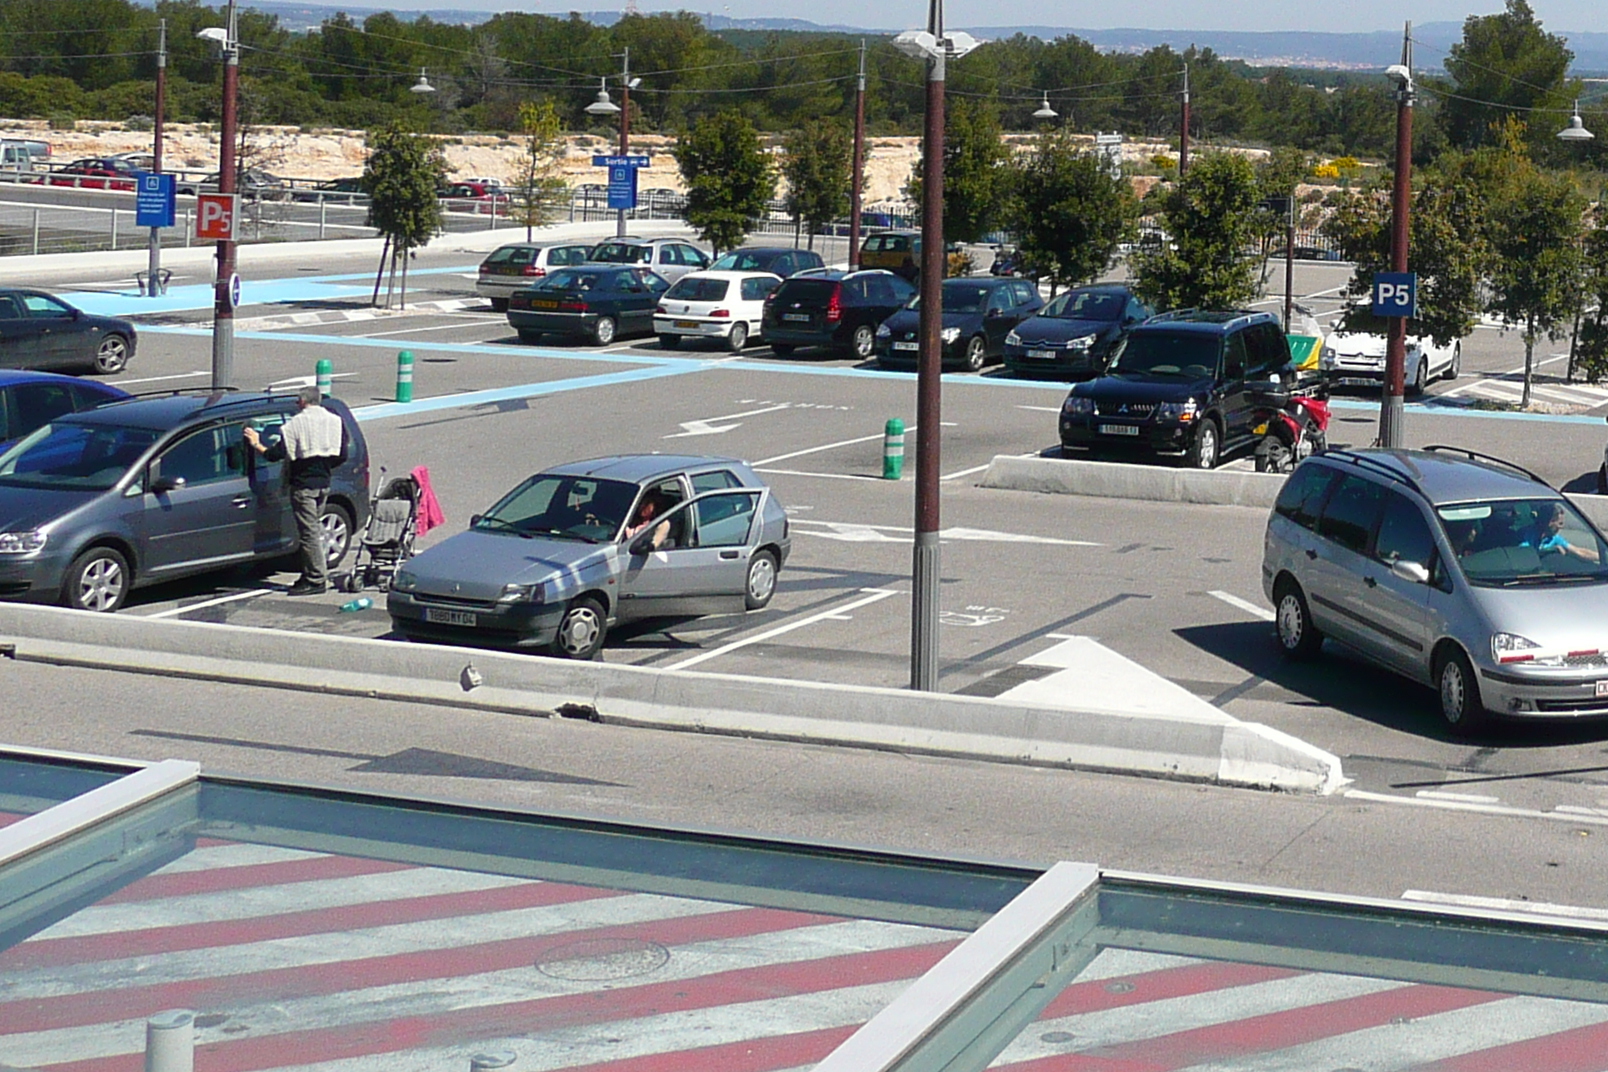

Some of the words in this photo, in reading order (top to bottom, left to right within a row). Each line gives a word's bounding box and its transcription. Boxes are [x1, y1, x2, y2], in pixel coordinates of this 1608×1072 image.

[605, 157, 628, 166] Sortie
[201, 201, 231, 232] P5
[1378, 283, 1409, 306] P5
